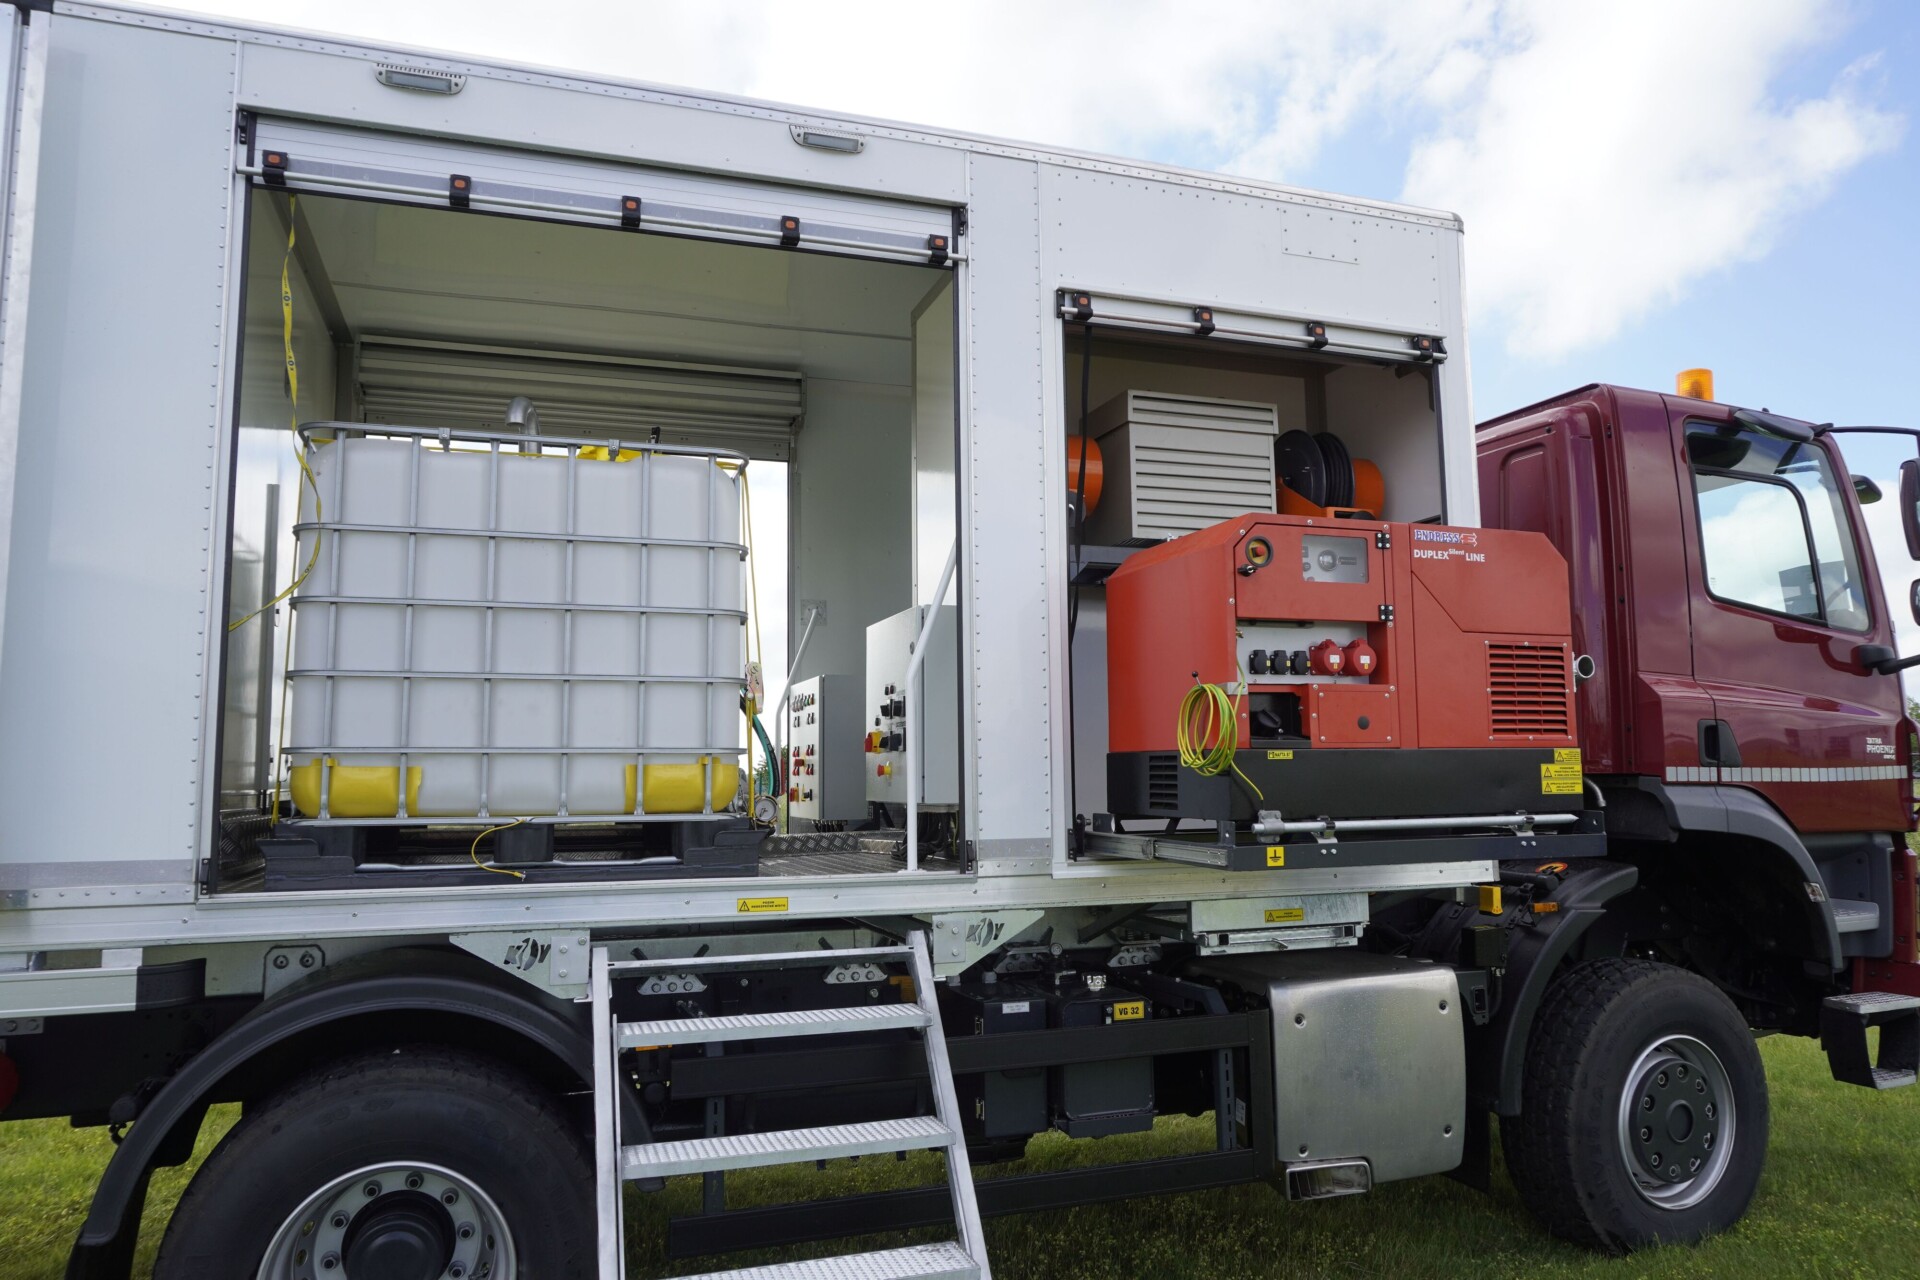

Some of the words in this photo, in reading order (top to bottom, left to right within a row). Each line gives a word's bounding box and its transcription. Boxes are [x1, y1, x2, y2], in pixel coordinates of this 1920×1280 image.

[1414, 529, 1461, 543] ENDRESS
[1413, 549, 1449, 560] DUPLEX
[1465, 552, 1486, 562] LINE
[1866, 745, 1896, 754] PHOENIX
[1118, 1007, 1129, 1016] VG
[1130, 1006, 1139, 1015] 32
